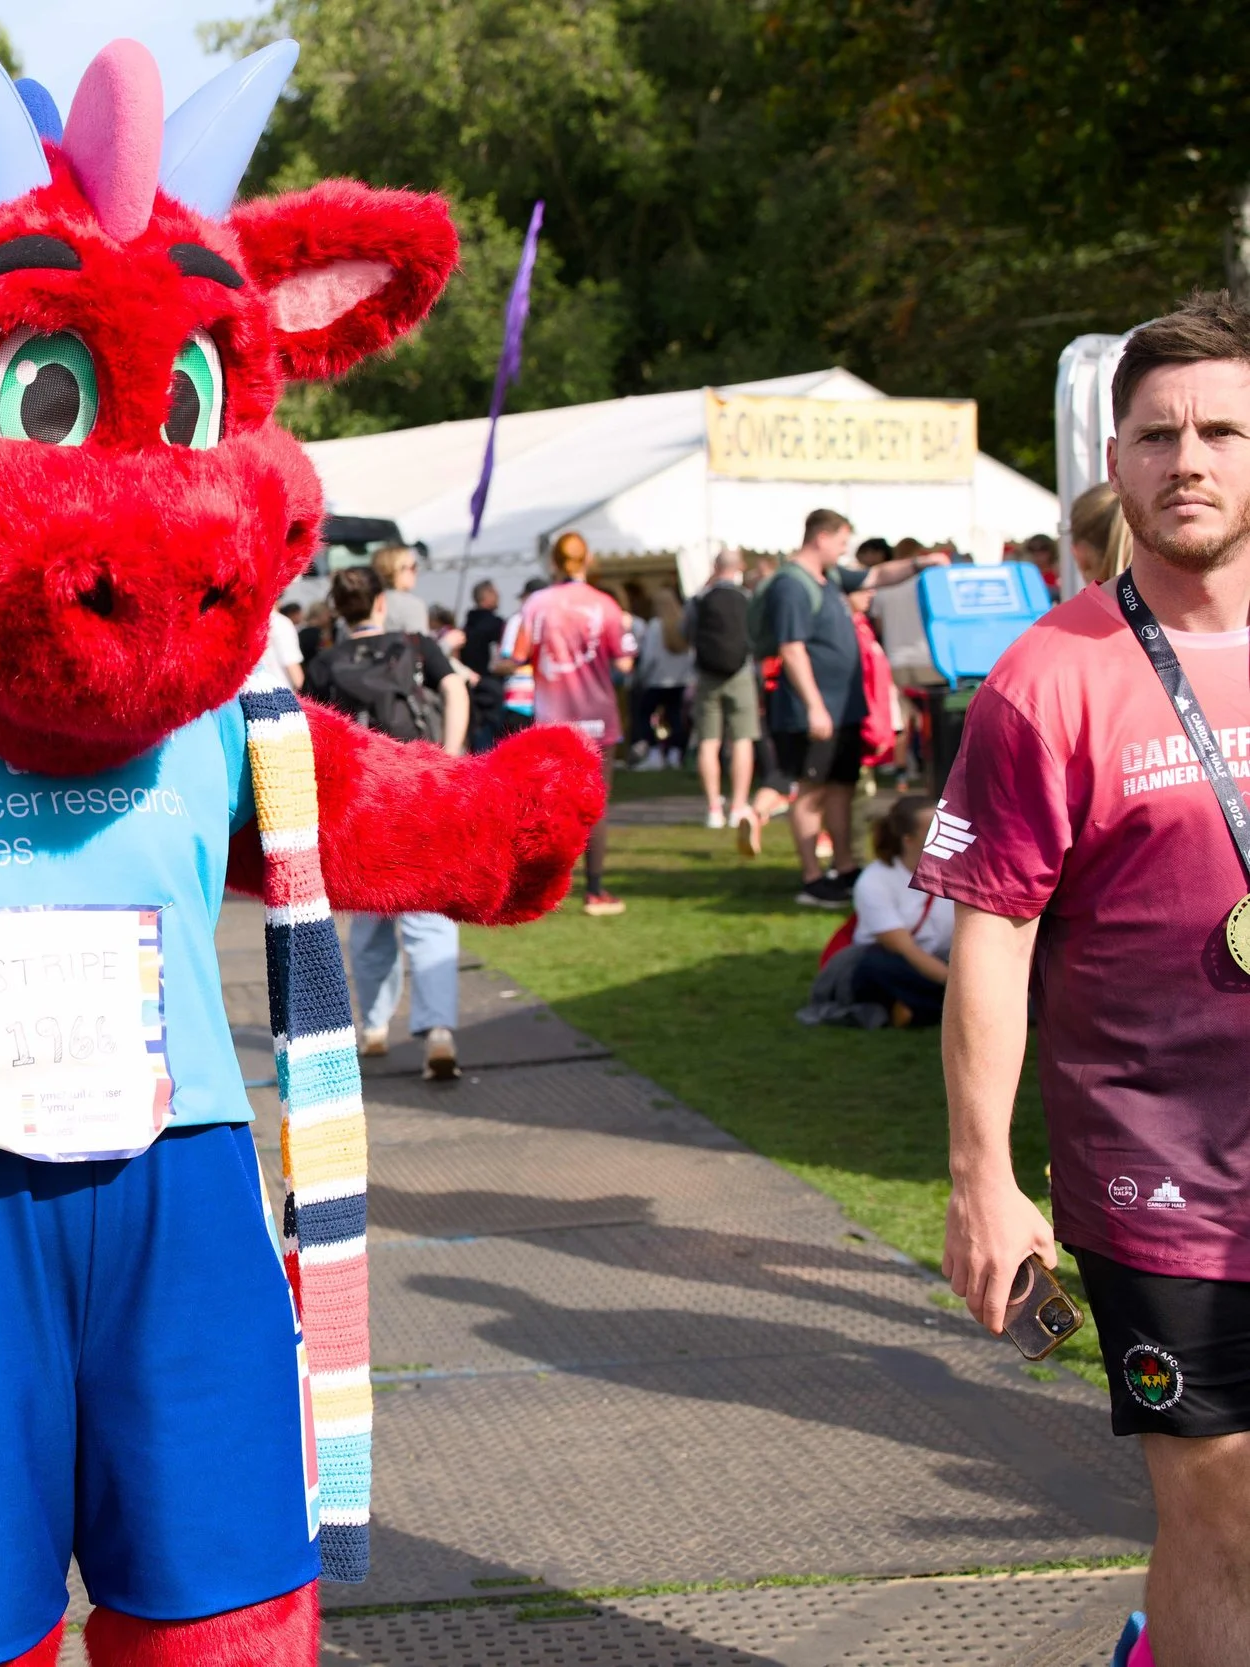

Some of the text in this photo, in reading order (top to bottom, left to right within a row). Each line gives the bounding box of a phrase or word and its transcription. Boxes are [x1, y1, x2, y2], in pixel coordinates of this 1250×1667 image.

[1122, 584, 1139, 611] 2026
[1190, 712, 1215, 752] CARDIFF
[1208, 752, 1228, 779] HALF
[1123, 765, 1199, 797] HANNER
[50, 784, 190, 817] research
[1226, 798, 1247, 828] 2026
[6, 1015, 118, 1068] 1966
